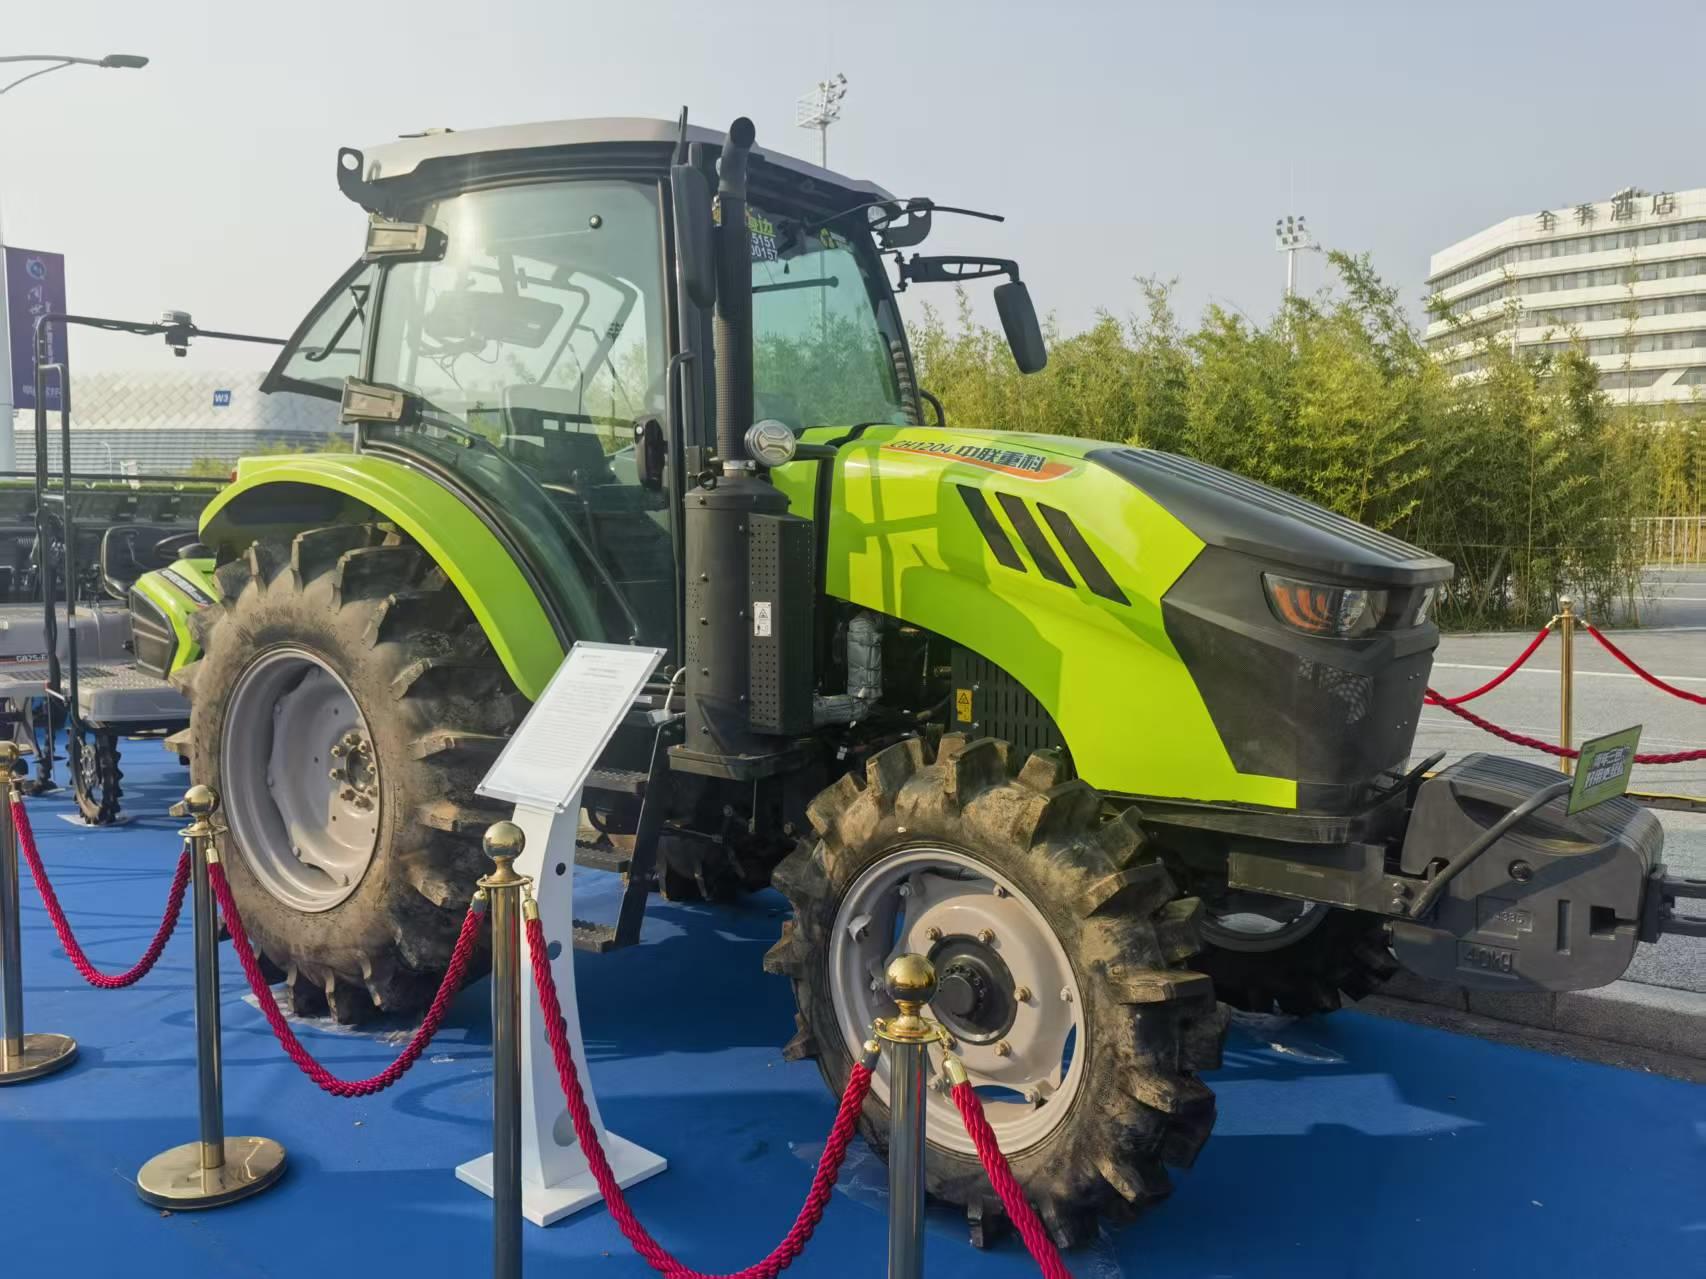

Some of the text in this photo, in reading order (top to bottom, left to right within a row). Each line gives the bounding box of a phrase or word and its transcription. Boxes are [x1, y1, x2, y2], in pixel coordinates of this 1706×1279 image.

[1536, 191, 1675, 232] 全季酒店
[890, 439, 952, 454] CH1204
[955, 444, 1046, 473] 中联重科
